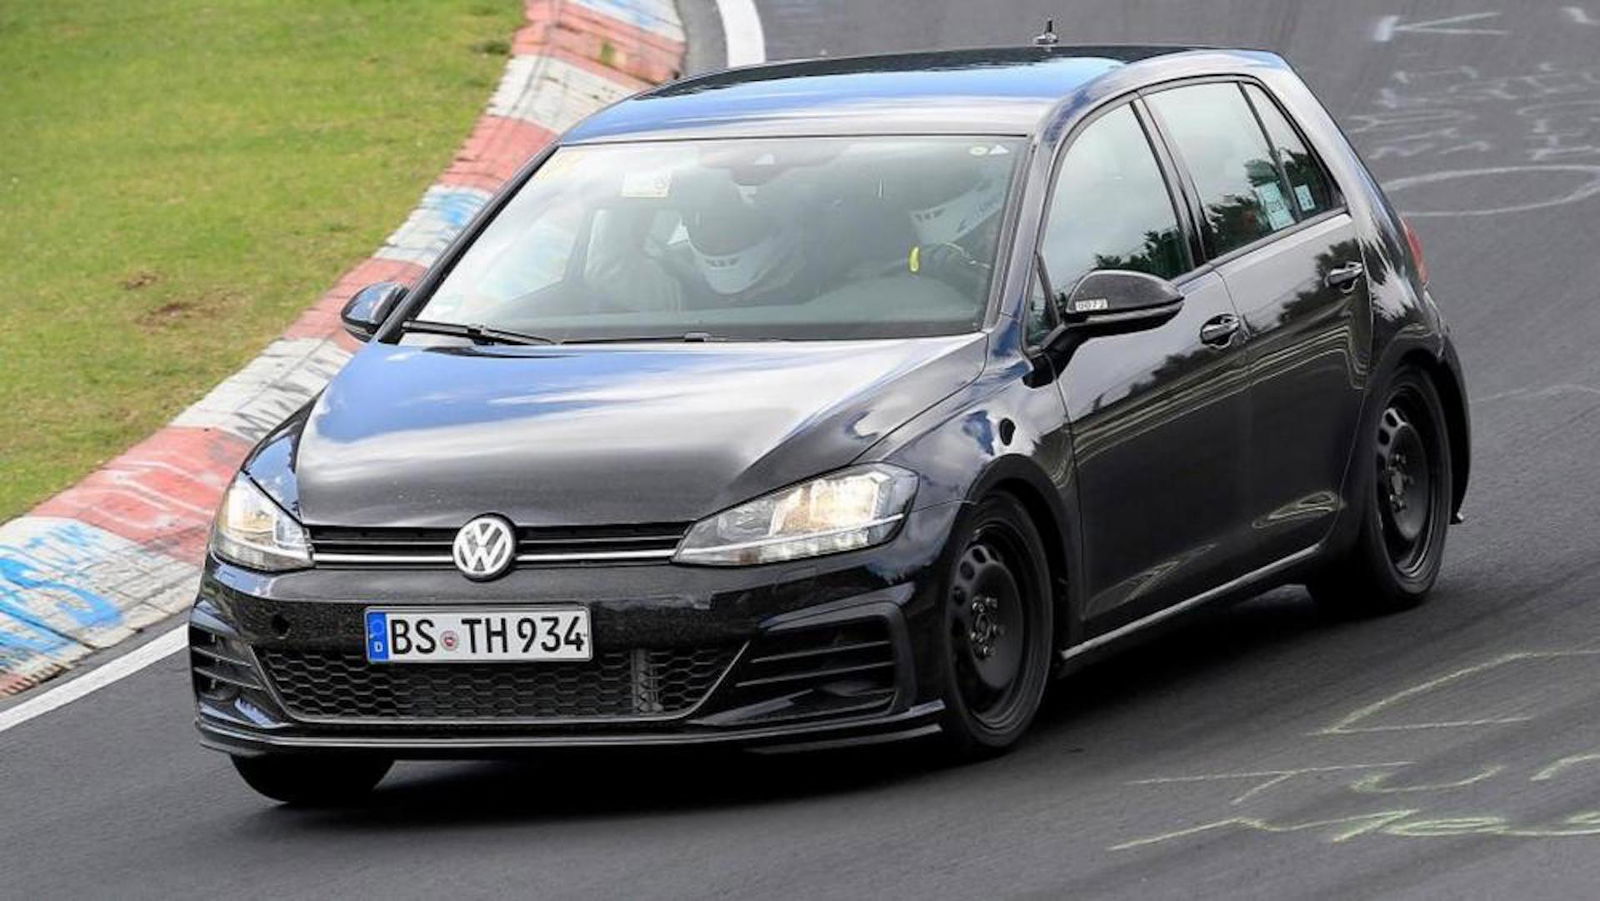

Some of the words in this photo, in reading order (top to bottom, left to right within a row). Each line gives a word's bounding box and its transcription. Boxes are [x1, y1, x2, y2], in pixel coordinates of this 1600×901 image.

[453, 517, 512, 575] VW
[373, 640, 384, 653] D
[390, 618, 437, 655] BS
[461, 617, 508, 653] TH
[516, 616, 585, 653] 934
